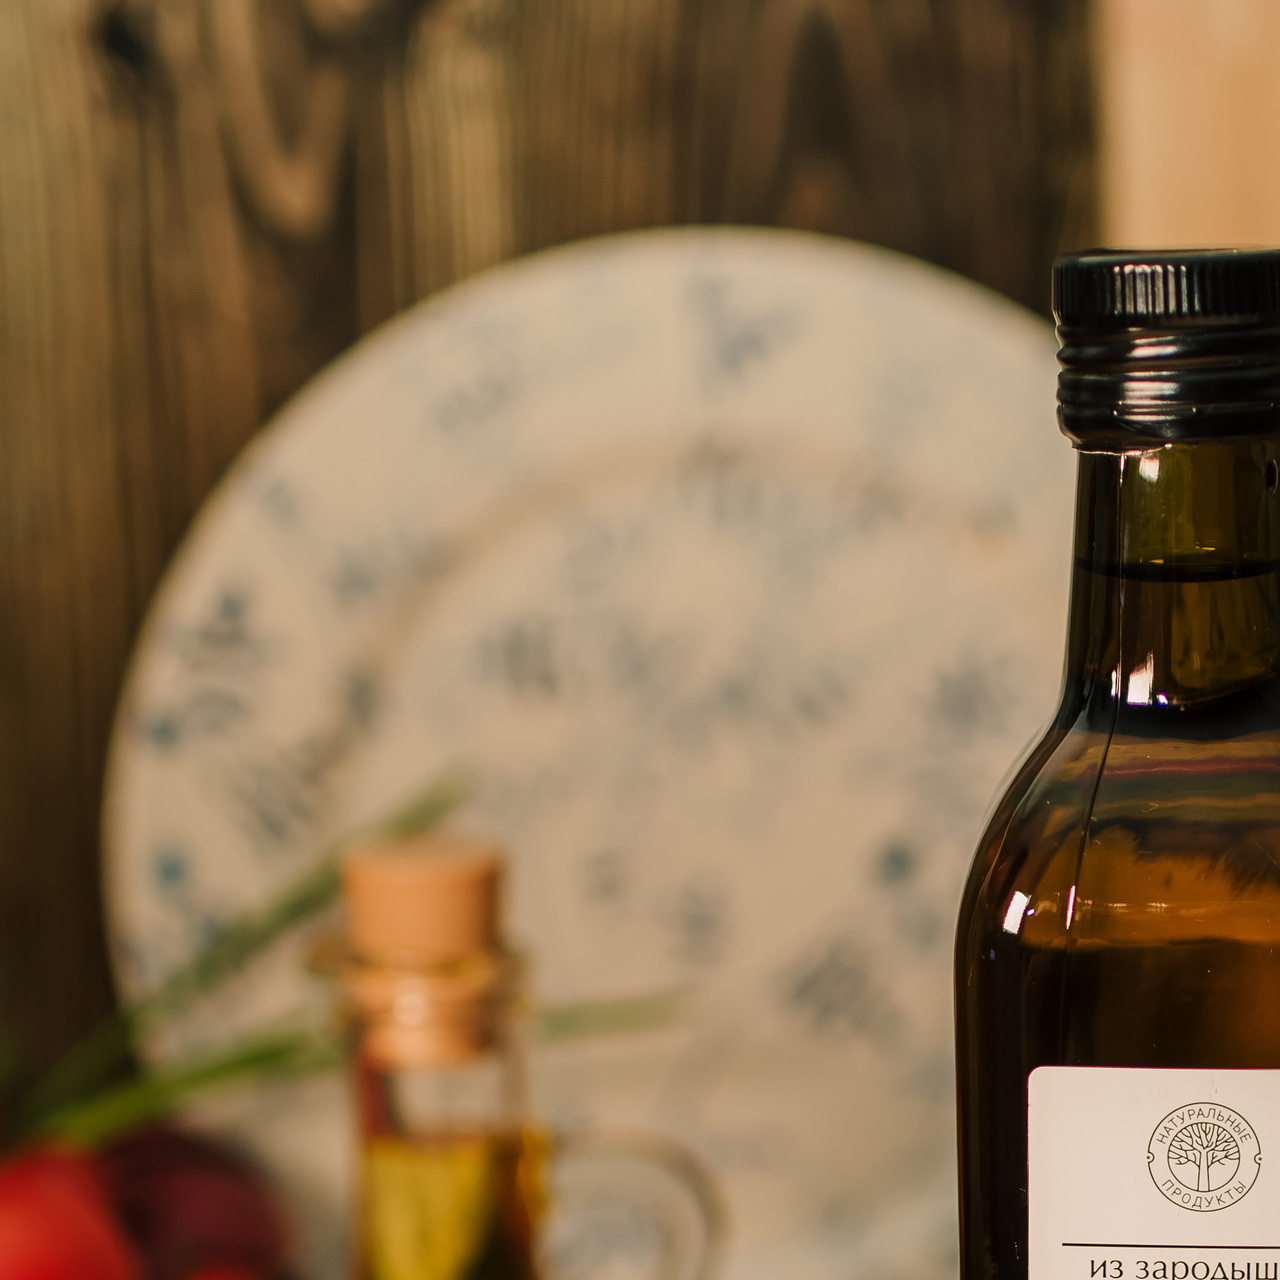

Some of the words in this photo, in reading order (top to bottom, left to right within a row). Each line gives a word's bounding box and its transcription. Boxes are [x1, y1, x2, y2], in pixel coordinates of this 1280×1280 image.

[1156, 1107, 1252, 1144] НАТУРАЛЬНЫЕ
[1161, 1179, 1247, 1209] ПРОДУКТЫ
[1089, 1259, 1124, 1279] из
